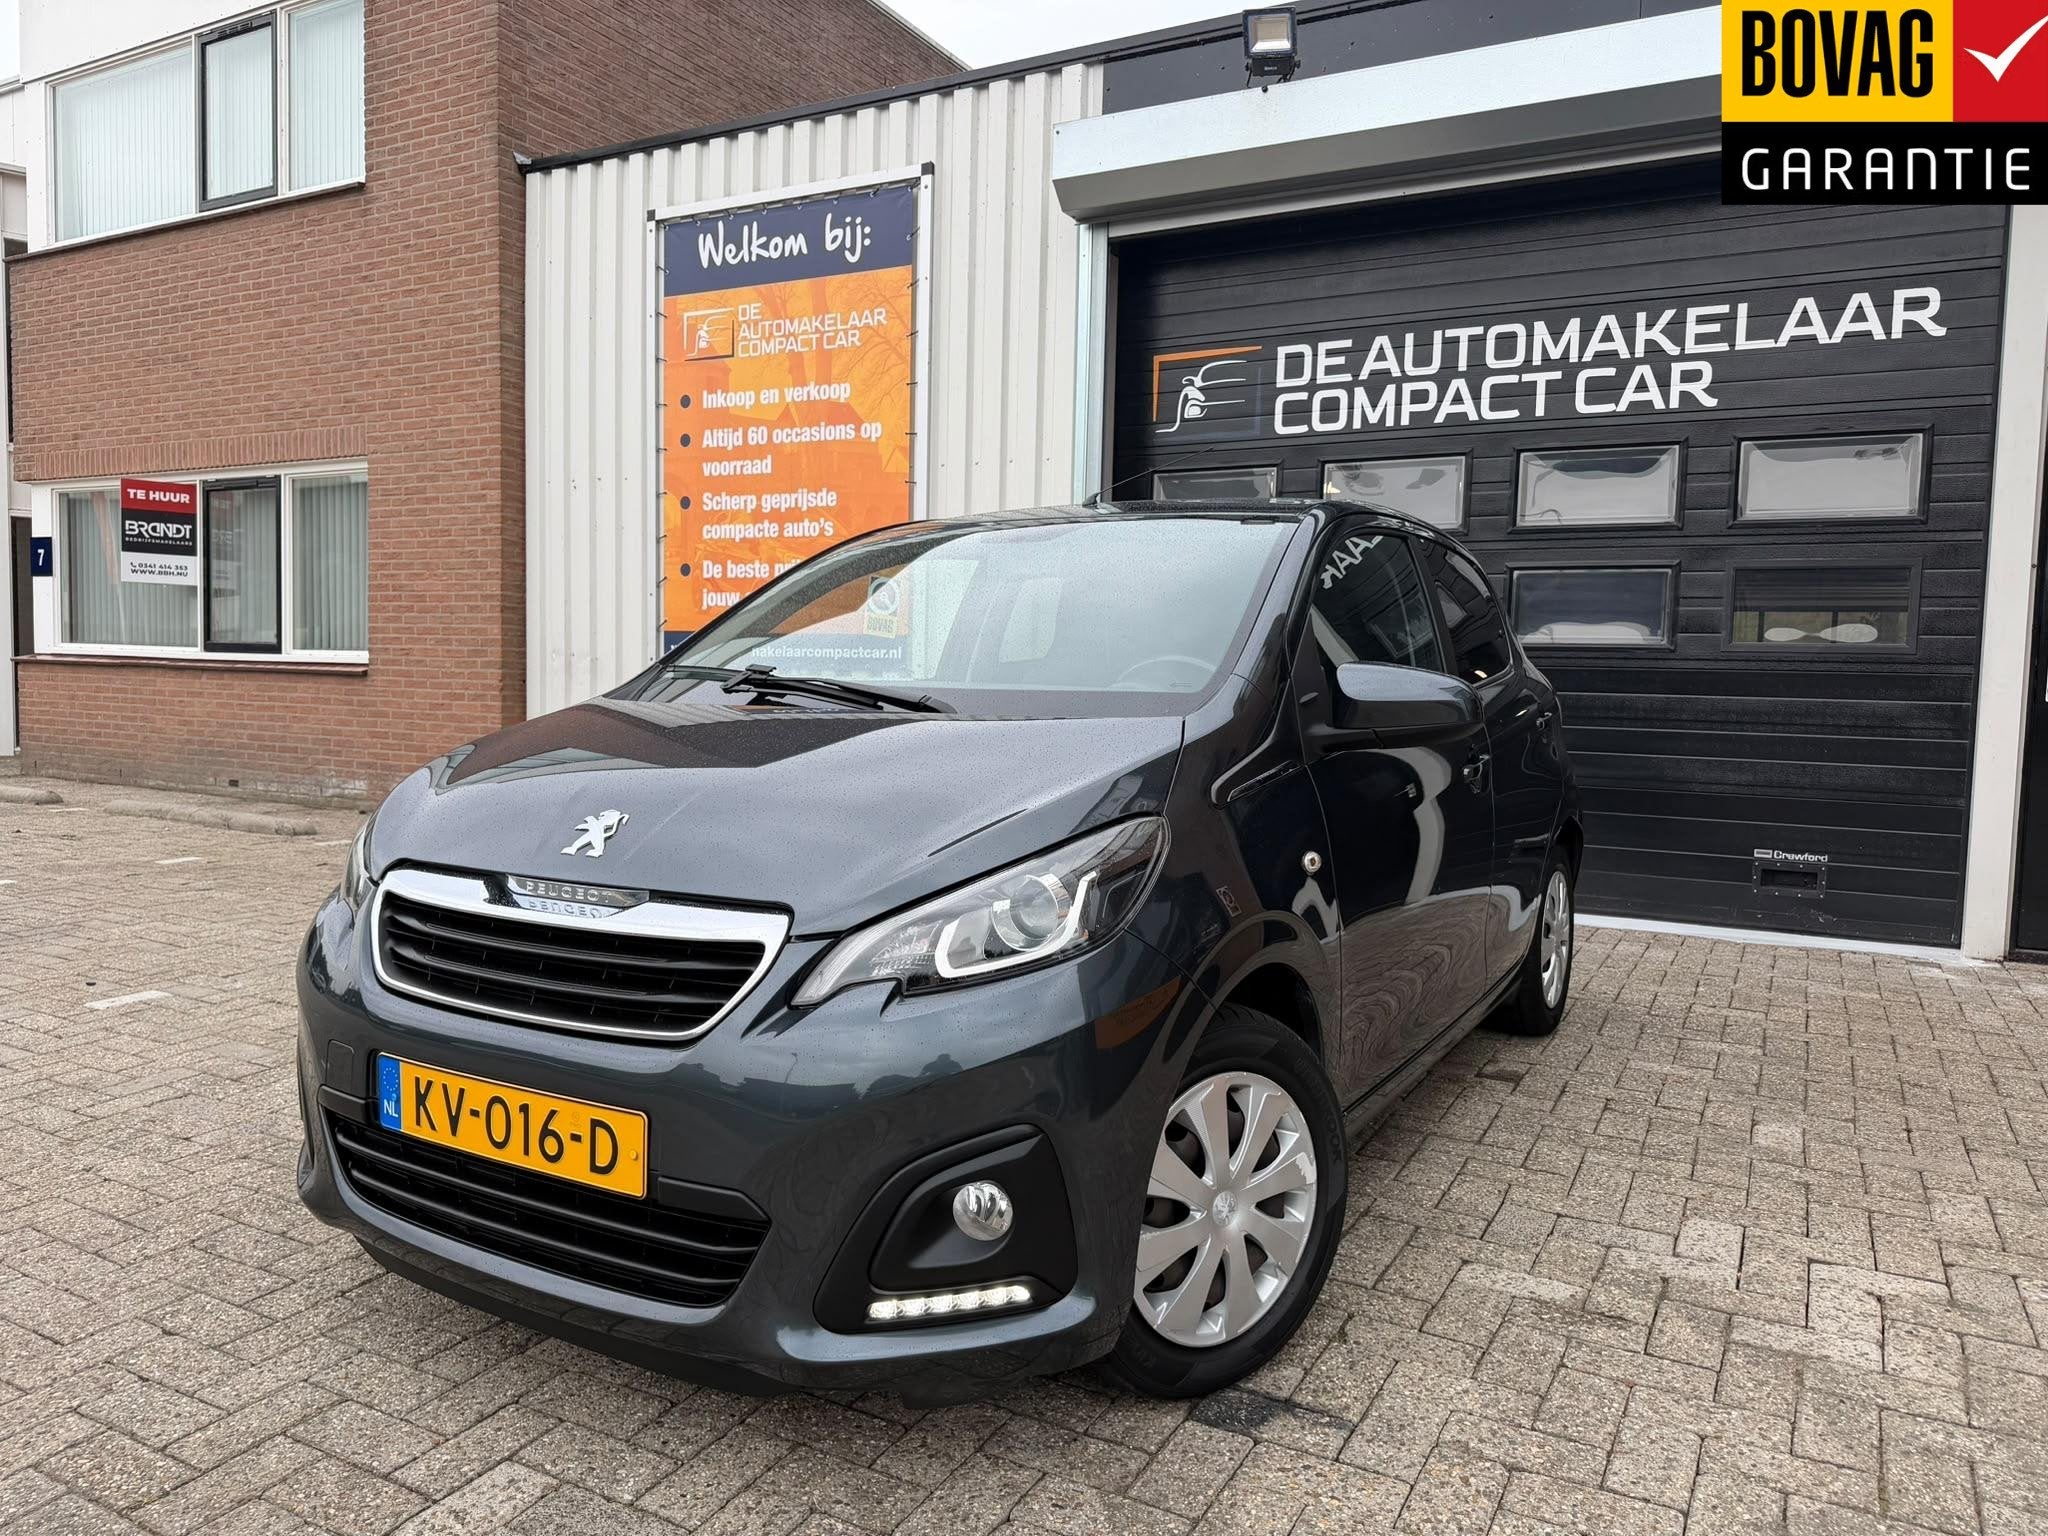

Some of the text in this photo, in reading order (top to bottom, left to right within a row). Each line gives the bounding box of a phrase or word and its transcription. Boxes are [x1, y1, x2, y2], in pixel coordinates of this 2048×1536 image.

[699, 212, 871, 269] Welkom bij:
[738, 303, 762, 320] DE
[738, 307, 887, 340] AUTOMAKELAAR
[739, 329, 861, 358] COMPACT CAR
[1276, 286, 1947, 388] DE AUTOMAKELAAR
[702, 381, 851, 410] Inkoop en verkoop
[1274, 360, 1718, 435] COMPACT CAR
[702, 421, 882, 450] Altijd 60 occasions op
[702, 454, 772, 477] voorraad
[127, 488, 190, 504] TE HUUR
[702, 487, 838, 514] Scherp geprijsde
[702, 517, 835, 542] compacte auto's
[37, 549, 45, 566] 7
[702, 560, 722, 578] De
[727, 559, 770, 578] beste
[702, 588, 741, 610] jouw
[1773, 849, 1828, 863] Crawford
[526, 880, 611, 903] PEUGEOT
[383, 1101, 399, 1118] NL
[414, 1076, 619, 1176] KV-016-D
